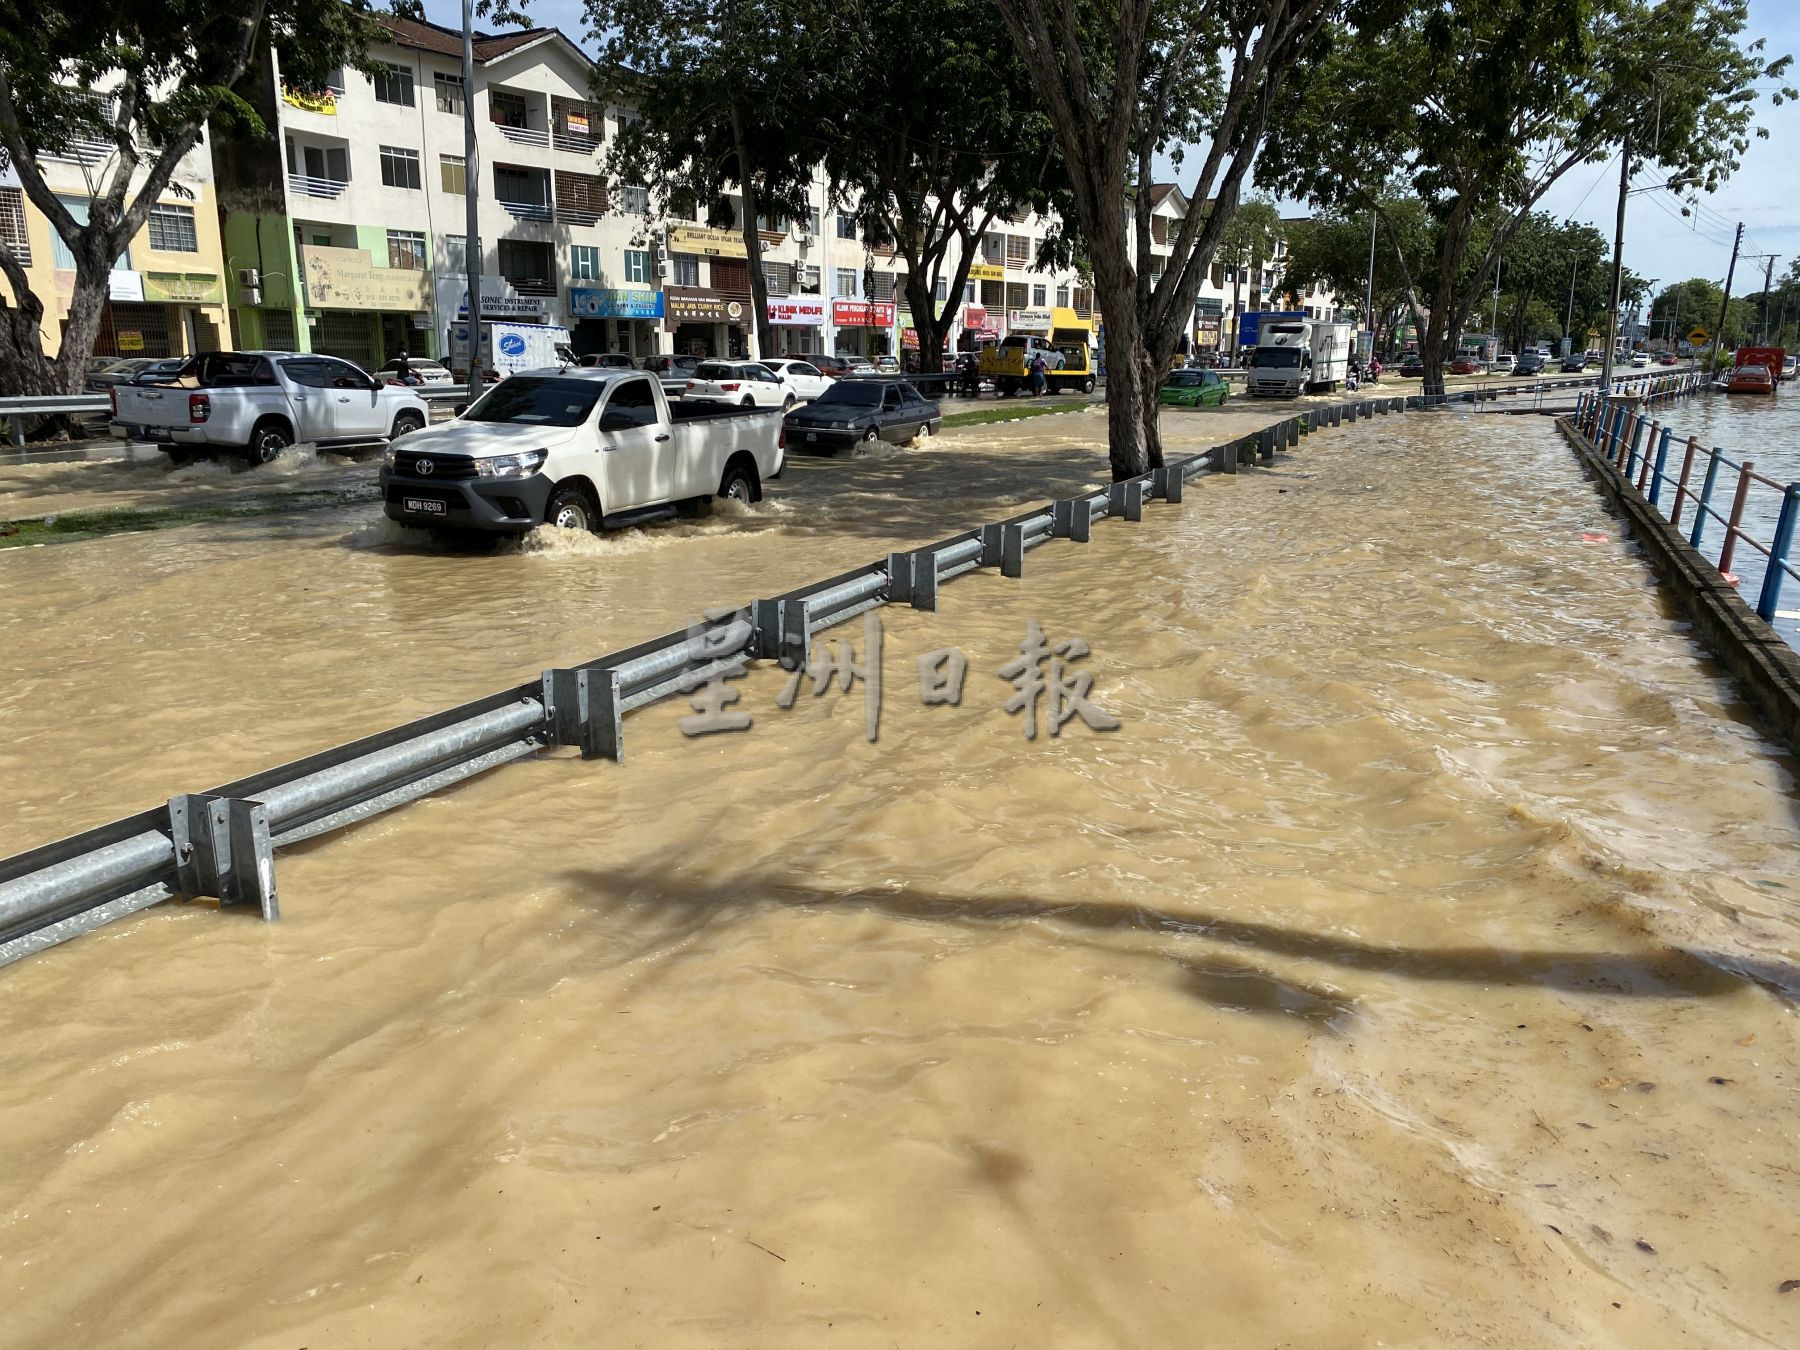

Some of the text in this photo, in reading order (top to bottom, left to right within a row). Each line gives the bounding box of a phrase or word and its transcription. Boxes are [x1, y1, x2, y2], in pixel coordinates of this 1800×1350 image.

[687, 232, 706, 240] BRILLIANT
[337, 269, 367, 279] Margaret
[481, 296, 502, 304] SONIC
[778, 305, 823, 316] KLINIK MEDLIFE
[837, 304, 849, 312] KLINIK
[423, 501, 442, 512] 9269
